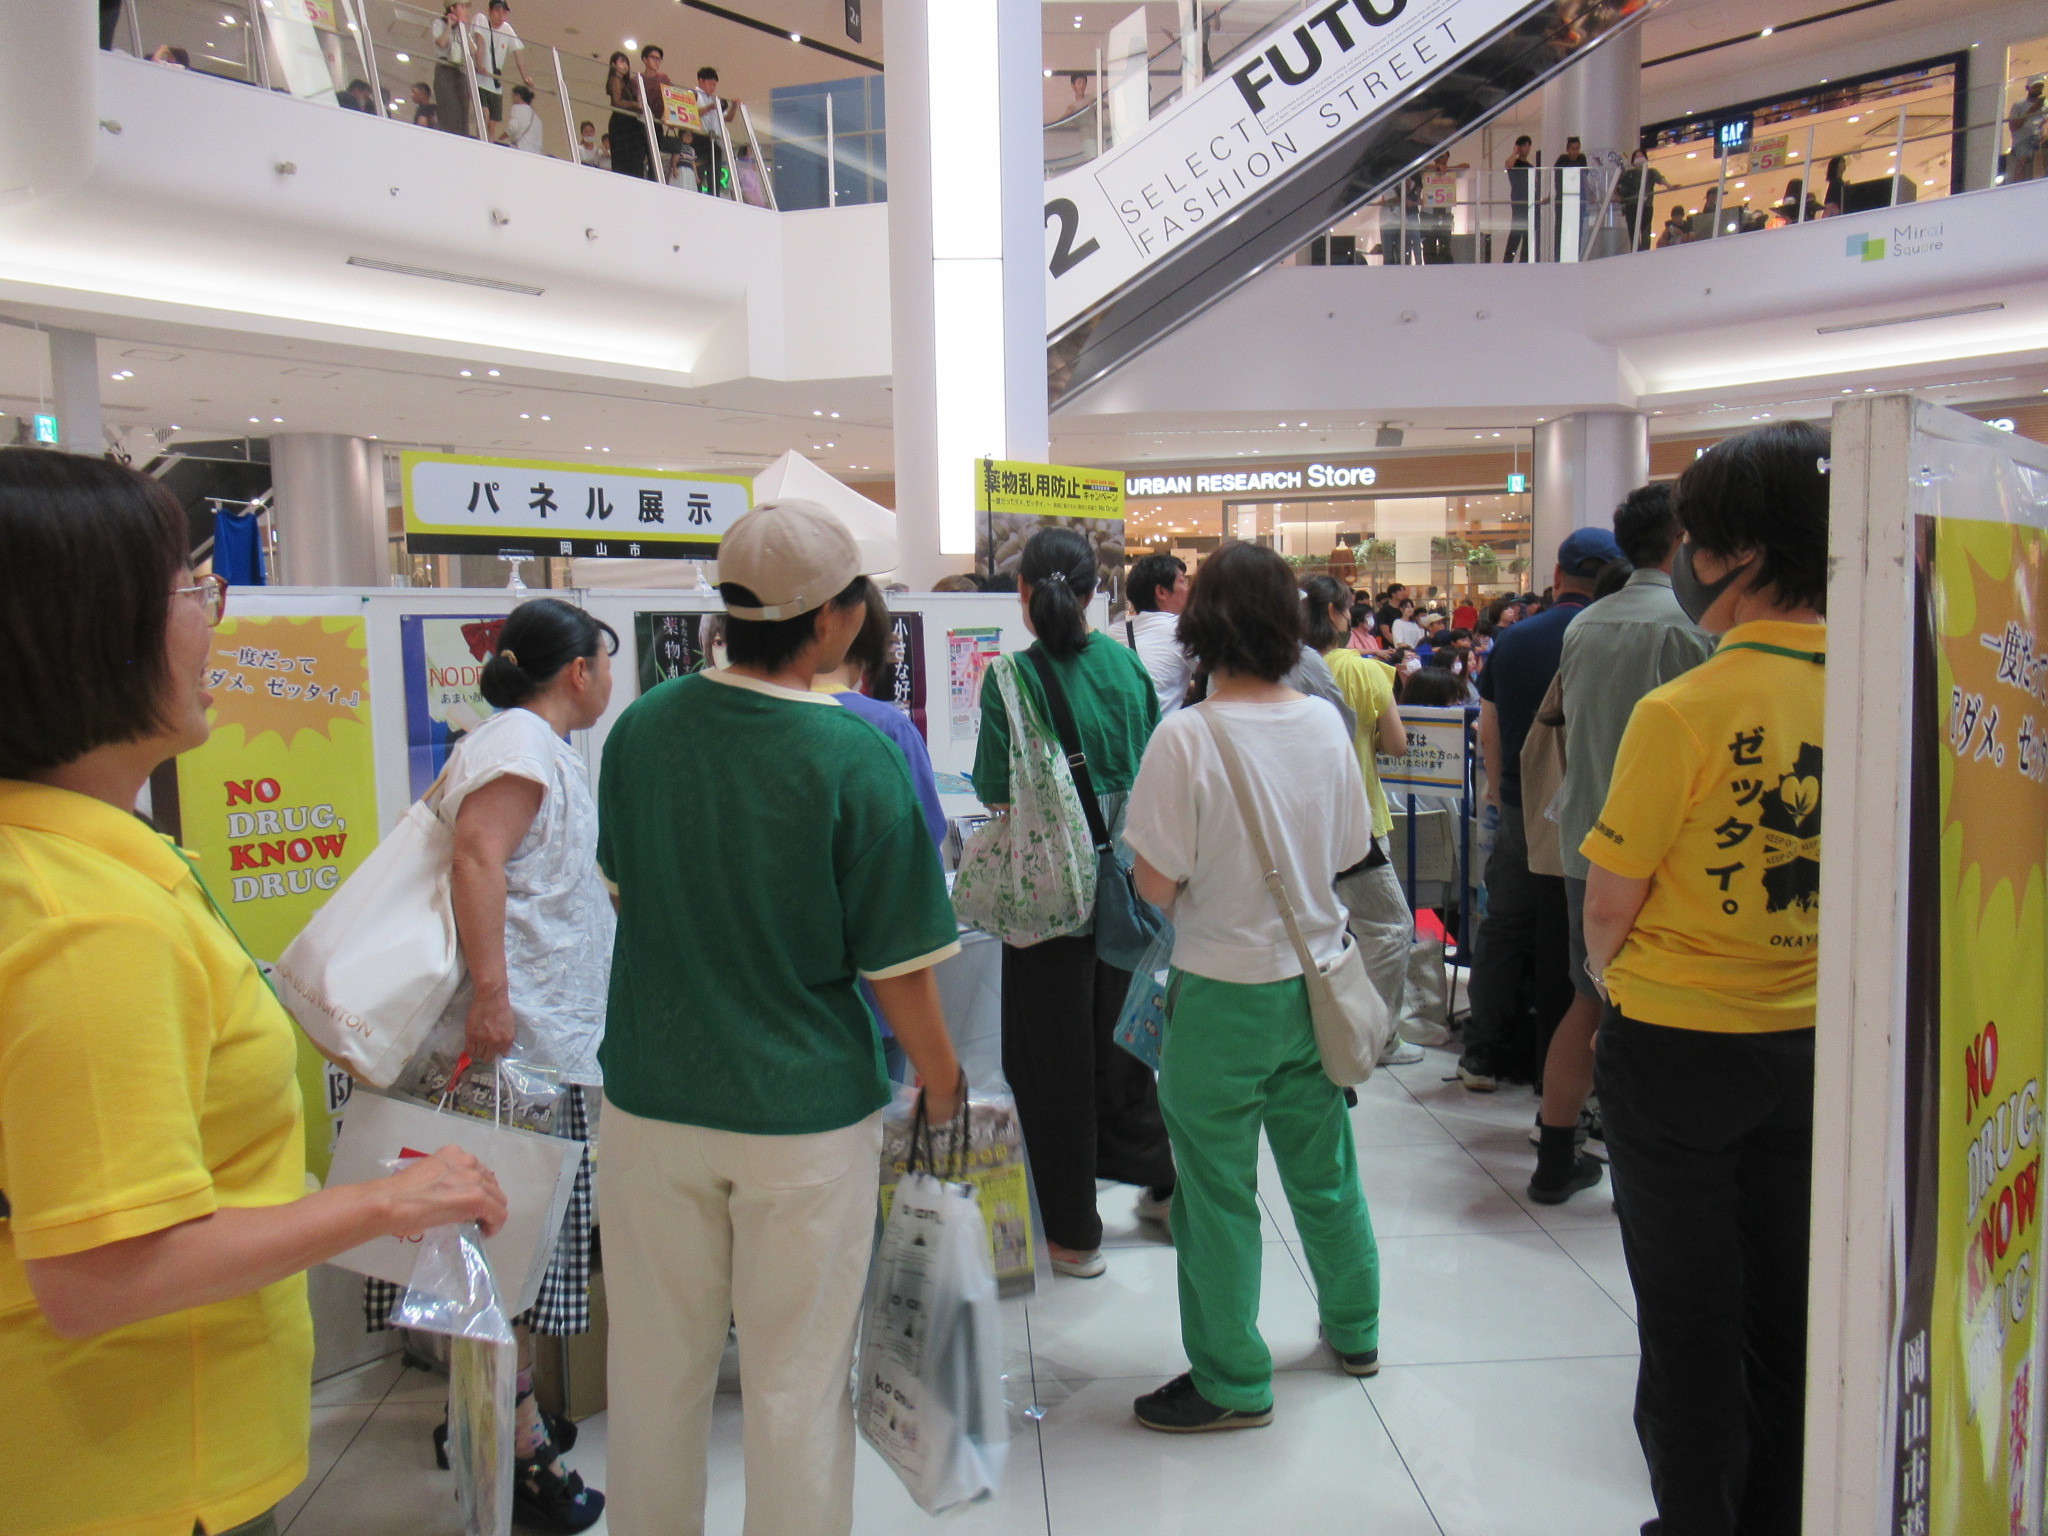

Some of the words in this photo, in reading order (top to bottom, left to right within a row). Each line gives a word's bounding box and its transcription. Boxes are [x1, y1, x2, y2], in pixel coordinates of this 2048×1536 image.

[1138, 132, 1298, 255] FASHION
[1319, 18, 1459, 128] STREET
[1721, 122, 1744, 143] GAP
[1120, 118, 1250, 224] SELECT
[1044, 197, 1100, 279] 2
[1893, 241, 1943, 257] Square
[1894, 223, 1944, 243] Mirai
[984, 469, 1082, 499] 薬物乱用防止
[1083, 491, 1118, 502] キャンペーン
[1126, 477, 1192, 496] URBAN
[1196, 471, 1301, 493] RESEARCH
[1307, 463, 1376, 488] Store
[467, 481, 713, 525] パネル展示
[559, 541, 641, 557] 岡山市
[217, 648, 317, 675] 一度だって
[224, 777, 281, 806] NO
[227, 804, 347, 839] DRUG,
[1705, 726, 1766, 915] ゼッタイ。
[228, 833, 348, 871] KNOW
[232, 865, 341, 904] DRUG
[1965, 1021, 1998, 1125] NO
